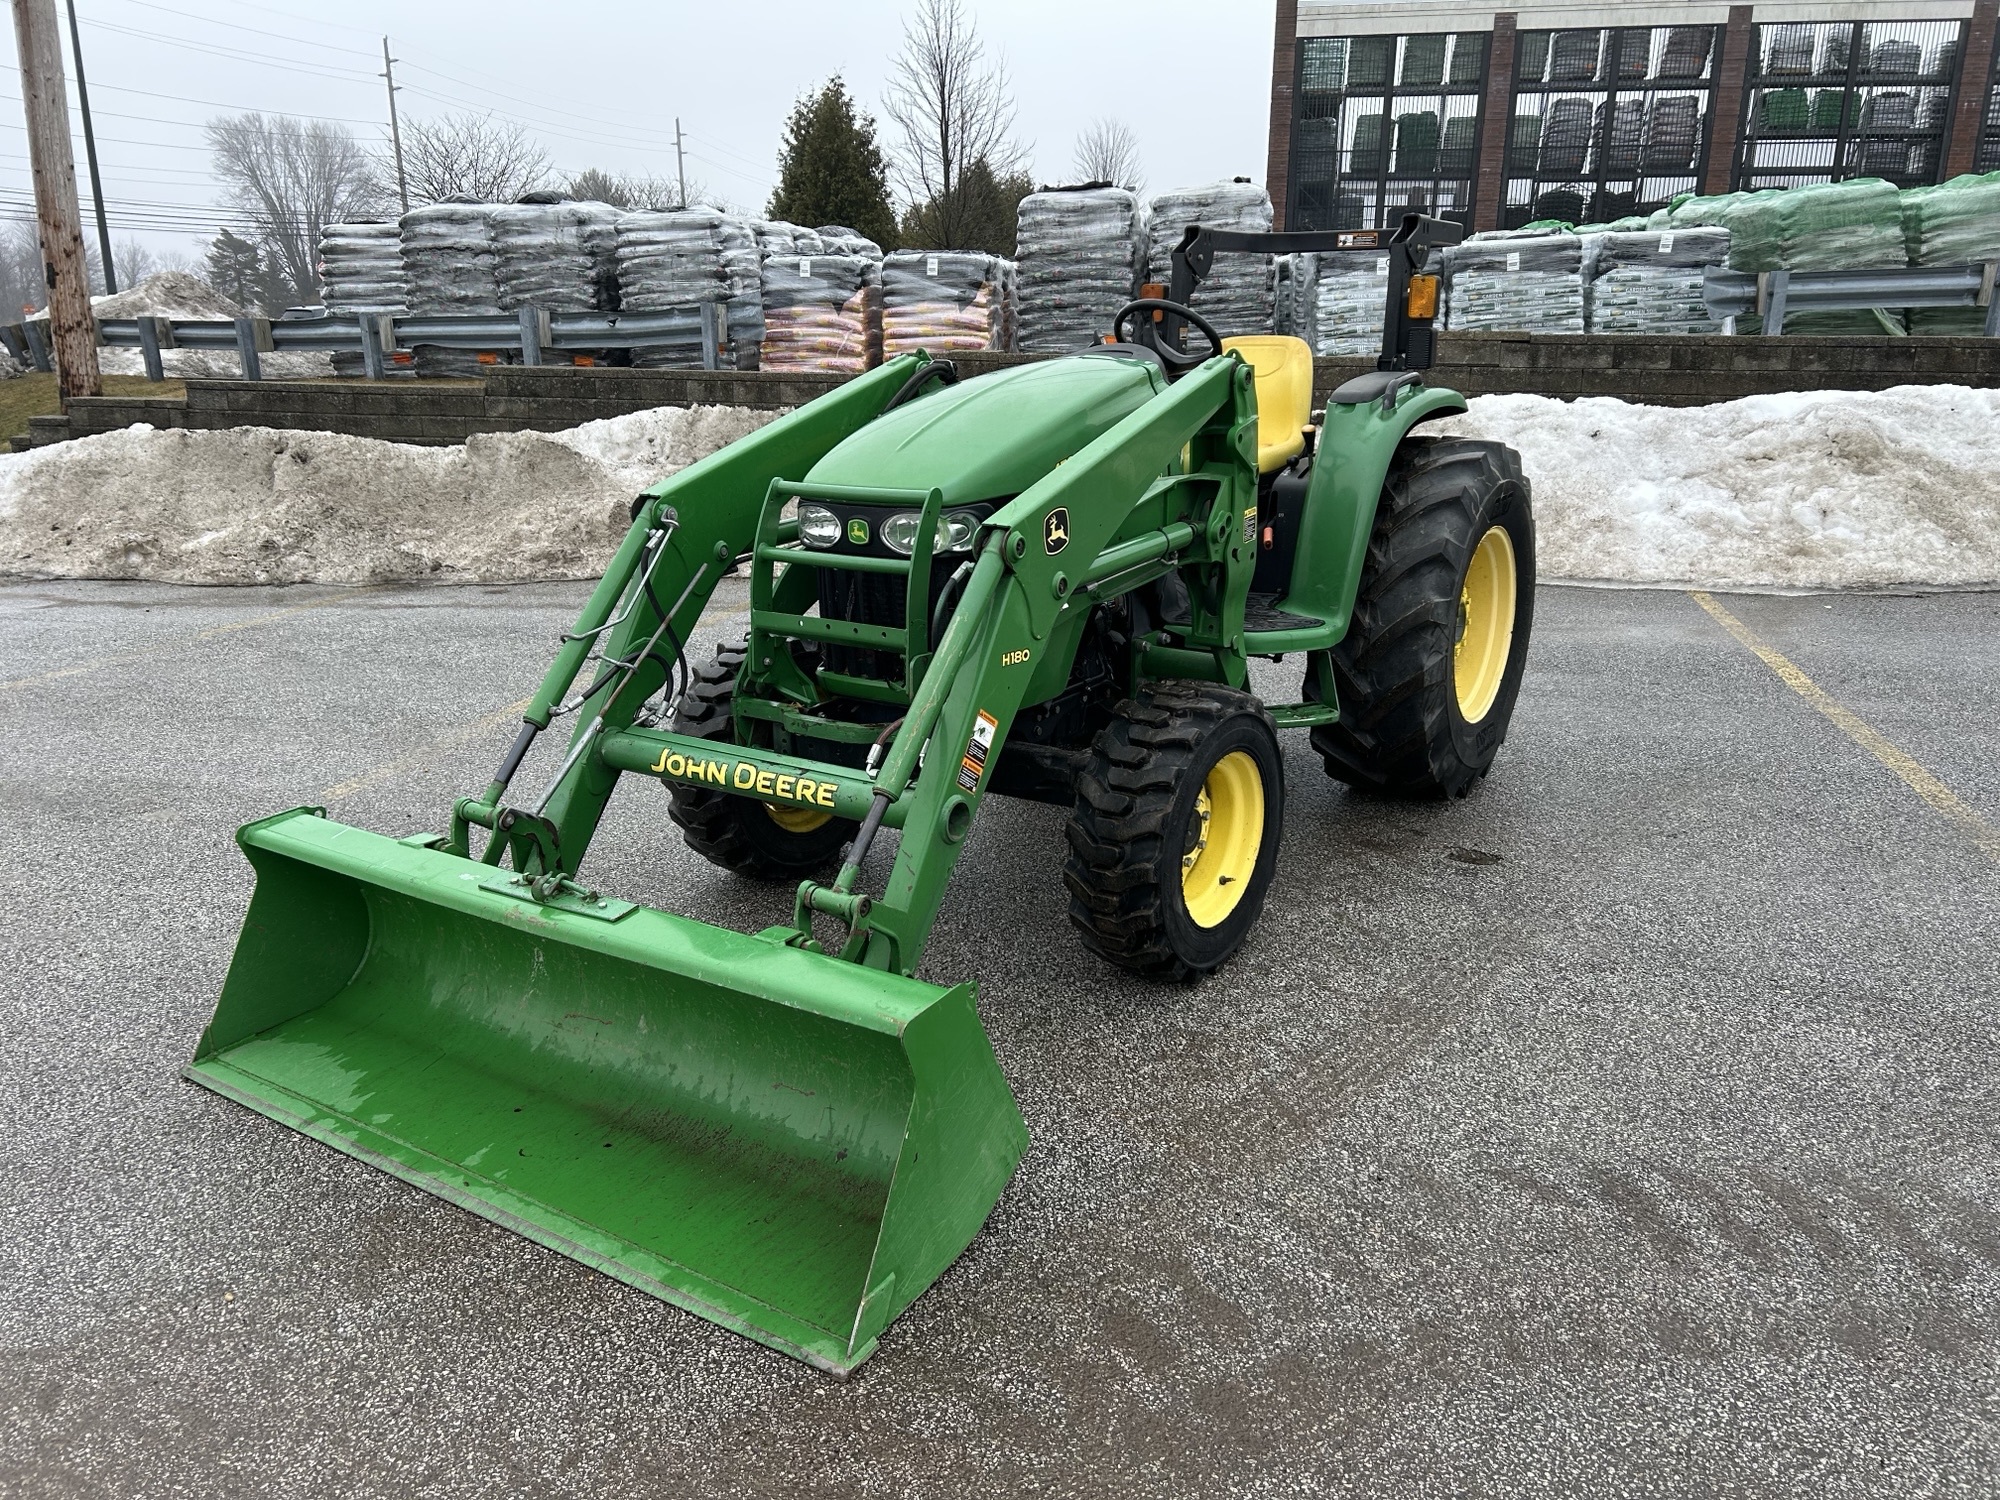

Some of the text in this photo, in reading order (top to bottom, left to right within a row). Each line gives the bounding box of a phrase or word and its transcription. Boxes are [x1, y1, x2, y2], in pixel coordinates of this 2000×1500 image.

[1002, 649, 1031, 667] H180
[650, 746, 841, 808] JOHN DEERE
